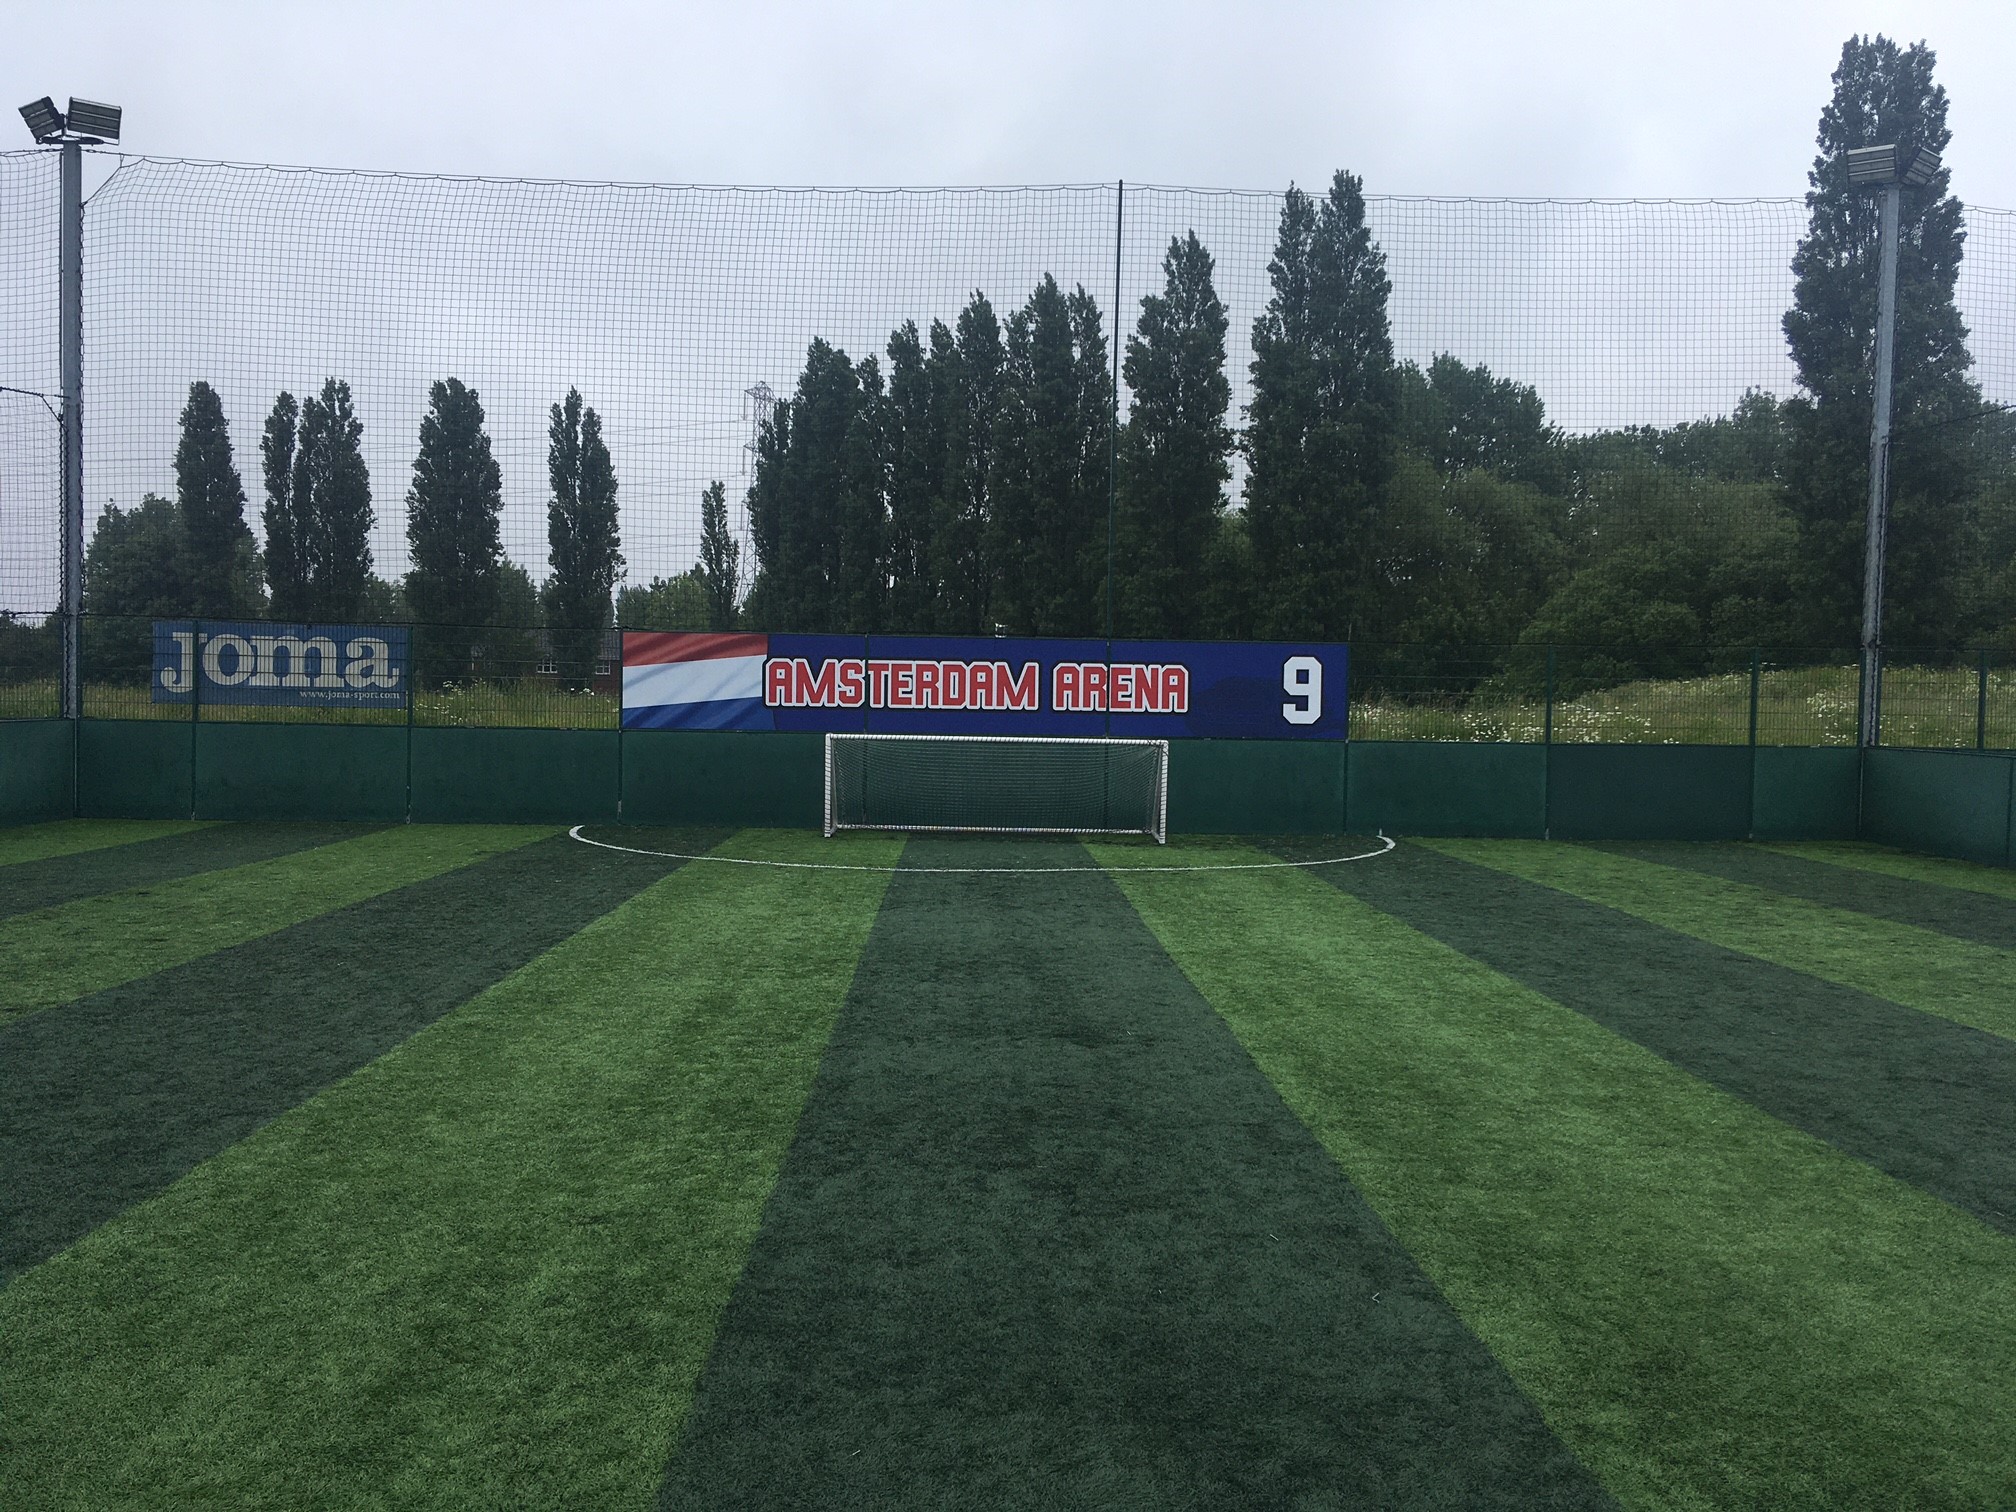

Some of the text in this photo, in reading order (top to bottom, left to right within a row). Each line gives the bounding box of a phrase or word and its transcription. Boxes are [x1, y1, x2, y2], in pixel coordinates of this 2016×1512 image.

[299, 690, 400, 701] www.joma-sport.com
[765, 658, 1189, 713] AMSTERDAM ARENA
[1282, 656, 1322, 725] 9
